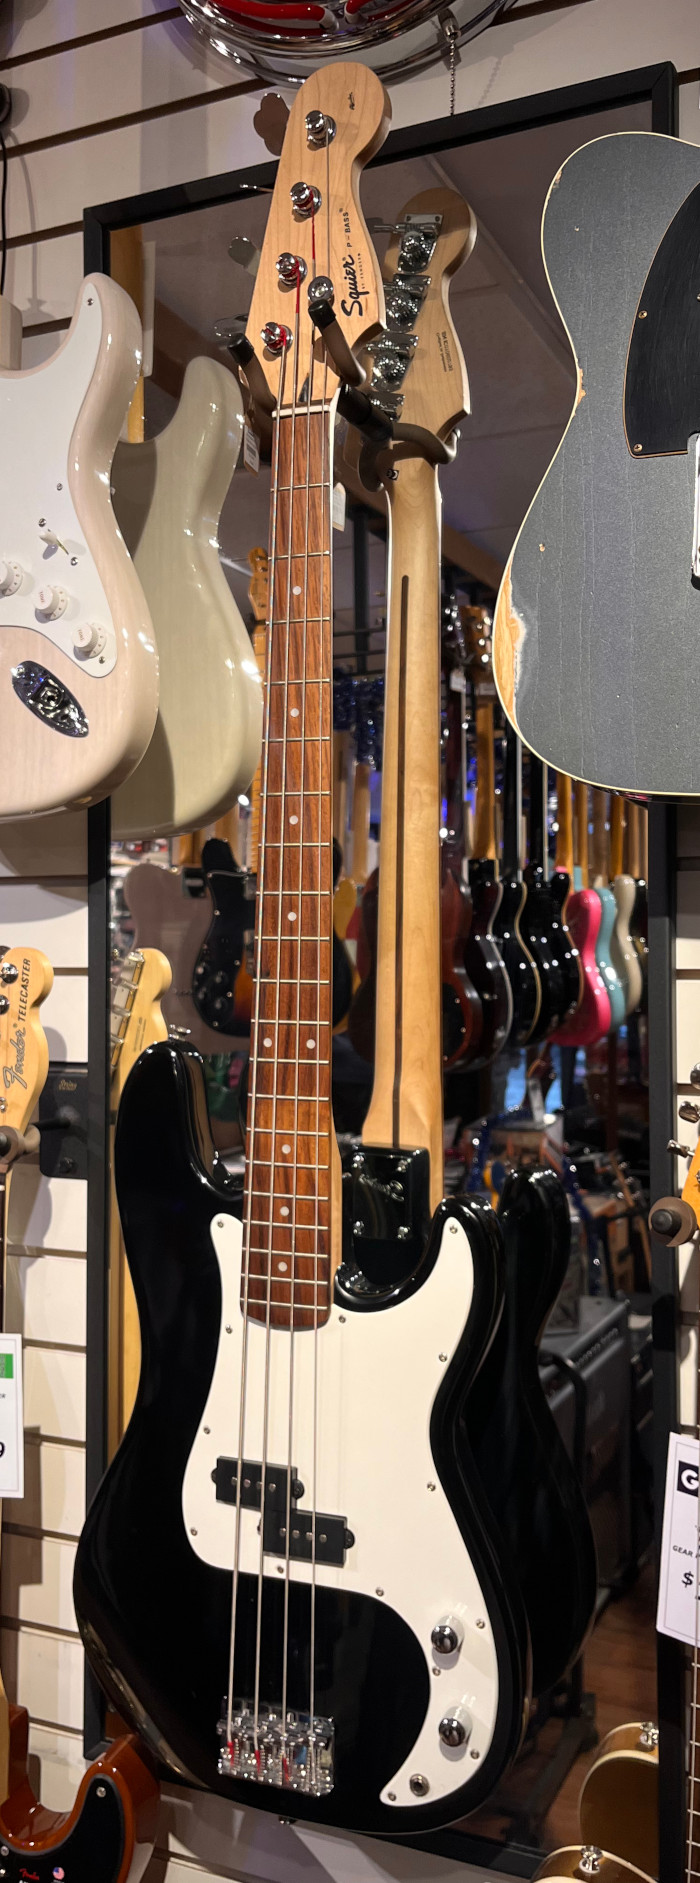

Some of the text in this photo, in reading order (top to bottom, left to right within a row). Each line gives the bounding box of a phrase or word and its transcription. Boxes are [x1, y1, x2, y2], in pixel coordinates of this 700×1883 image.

[341, 254, 370, 317] Squier
[18, 958, 31, 1022] TELECASTER
[2, 1027, 28, 1090] Fender
[672, 1545, 693, 1557] GEAR
